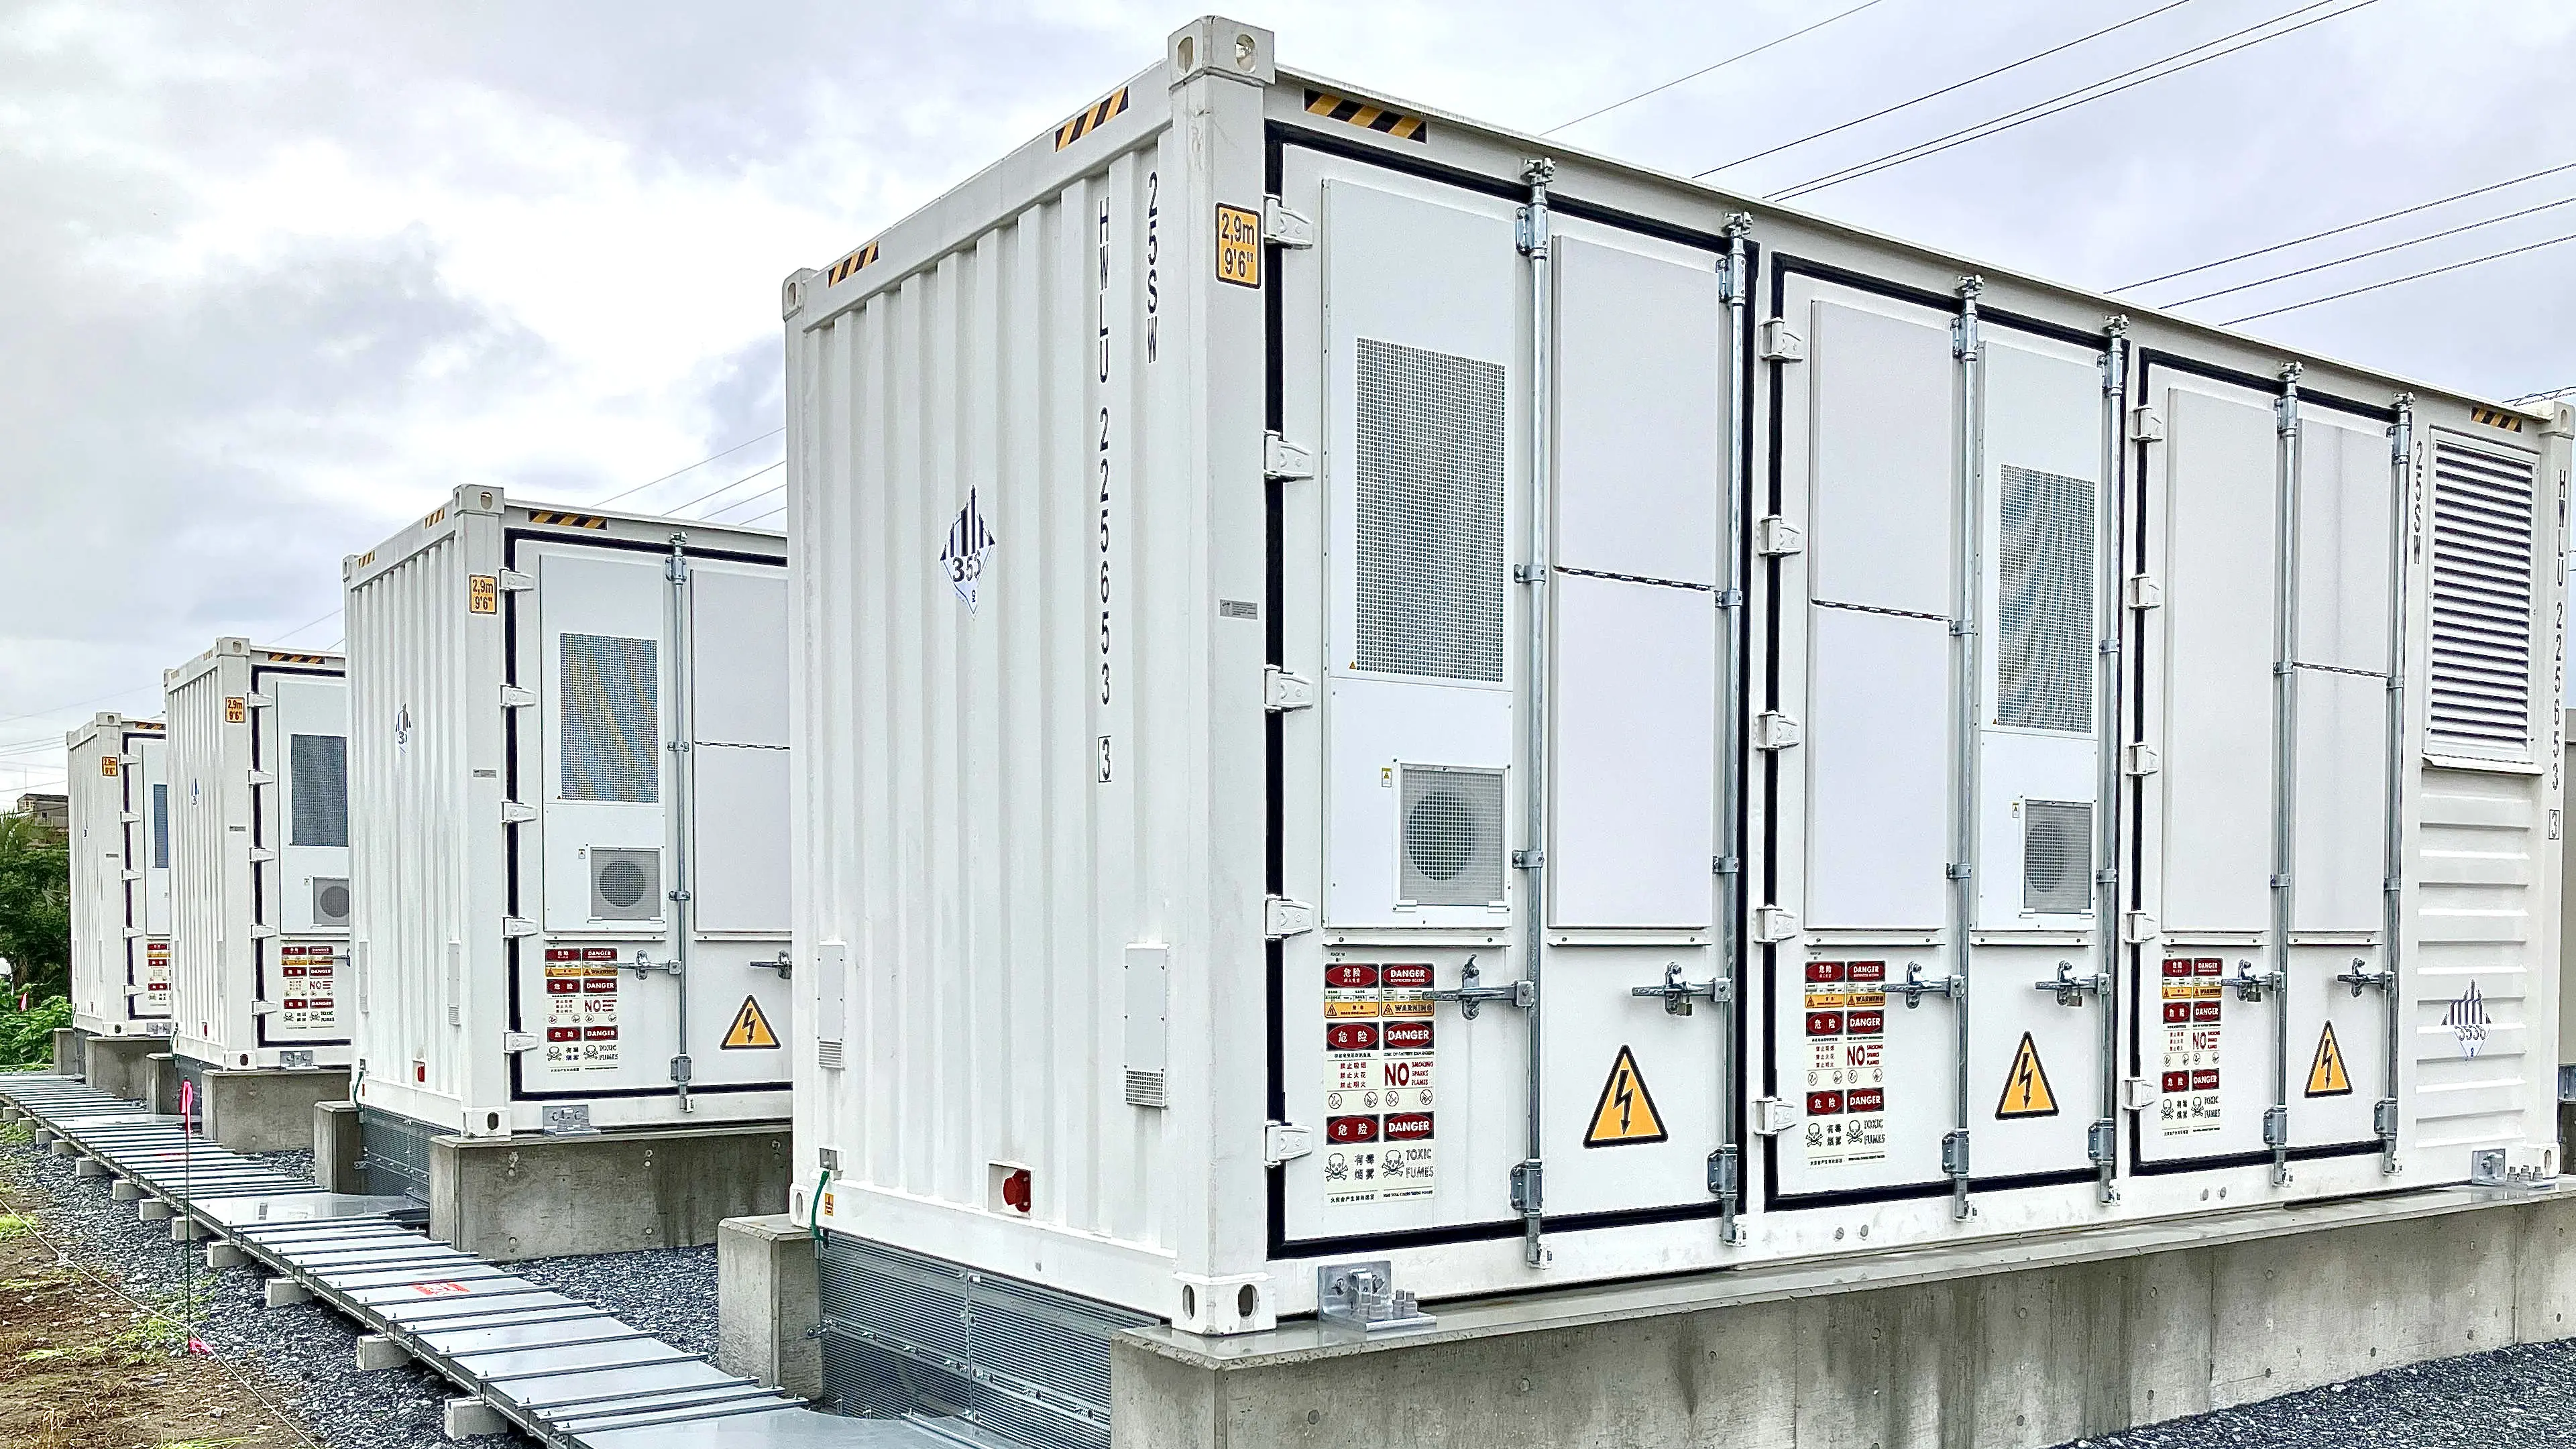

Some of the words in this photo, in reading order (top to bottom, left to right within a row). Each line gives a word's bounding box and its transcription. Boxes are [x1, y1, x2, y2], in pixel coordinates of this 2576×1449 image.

[1221, 212, 1255, 247] 2,9m
[1147, 171, 1158, 364] 25SW
[1099, 196, 1109, 384] HWLU
[2414, 441, 2423, 565] 25SW
[2557, 469, 2567, 587] HWLU
[1099, 406, 1110, 705] 225653
[472, 579, 494, 595] 2,9m
[2553, 601, 2563, 791] 225653
[1343, 968, 1361, 978] 危险
[1390, 970, 1425, 978] DANGER
[584, 999, 602, 1012] NO
[1394, 1004, 1433, 1012] WARNING
[2195, 1007, 2219, 1015] DANGER
[1850, 1017, 1881, 1027] DANGER
[1338, 1031, 1367, 1043] 危险
[1388, 1030, 1430, 1041] DANGER
[2192, 1031, 2206, 1050] NO
[1847, 1045, 1865, 1065] NO
[1384, 1062, 1410, 1086] NO
[2193, 1075, 2217, 1084] DANGER
[1850, 1095, 1881, 1106] DANGER
[1338, 1122, 1368, 1136] 危险
[1388, 1121, 1430, 1133] DANGER
[1864, 1118, 1883, 1130] TOXIC
[1864, 1134, 1885, 1145] FUMES
[1406, 1149, 1432, 1161] TOXIC
[1406, 1166, 1434, 1179] FUMES
